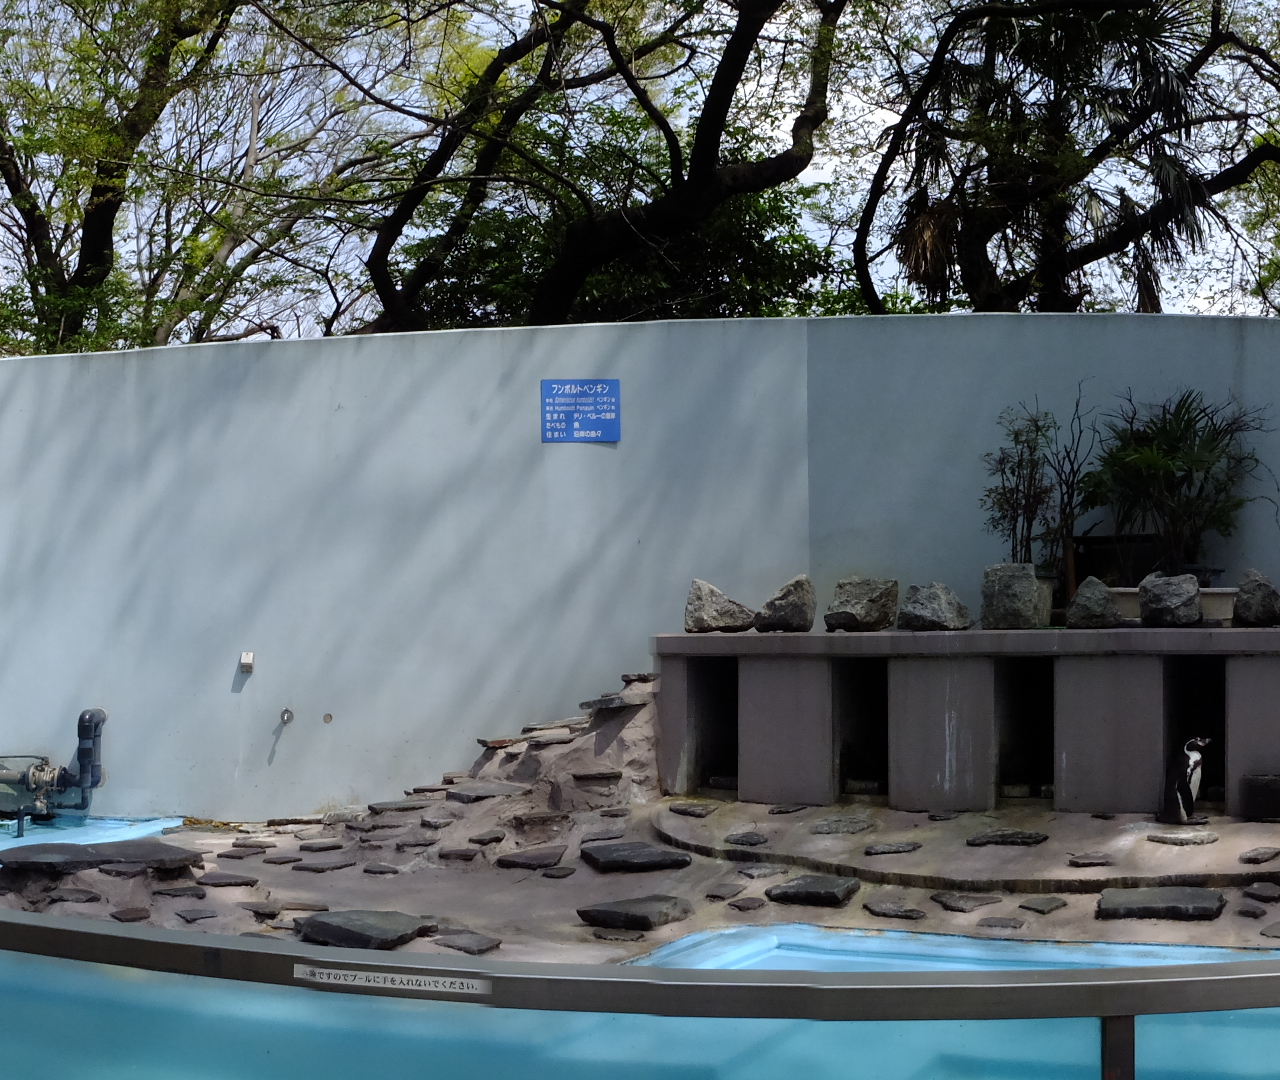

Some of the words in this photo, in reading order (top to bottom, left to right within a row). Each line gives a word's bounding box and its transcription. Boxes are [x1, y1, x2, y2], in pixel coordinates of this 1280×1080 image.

[552, 384, 609, 394] フンボルトペンギン
